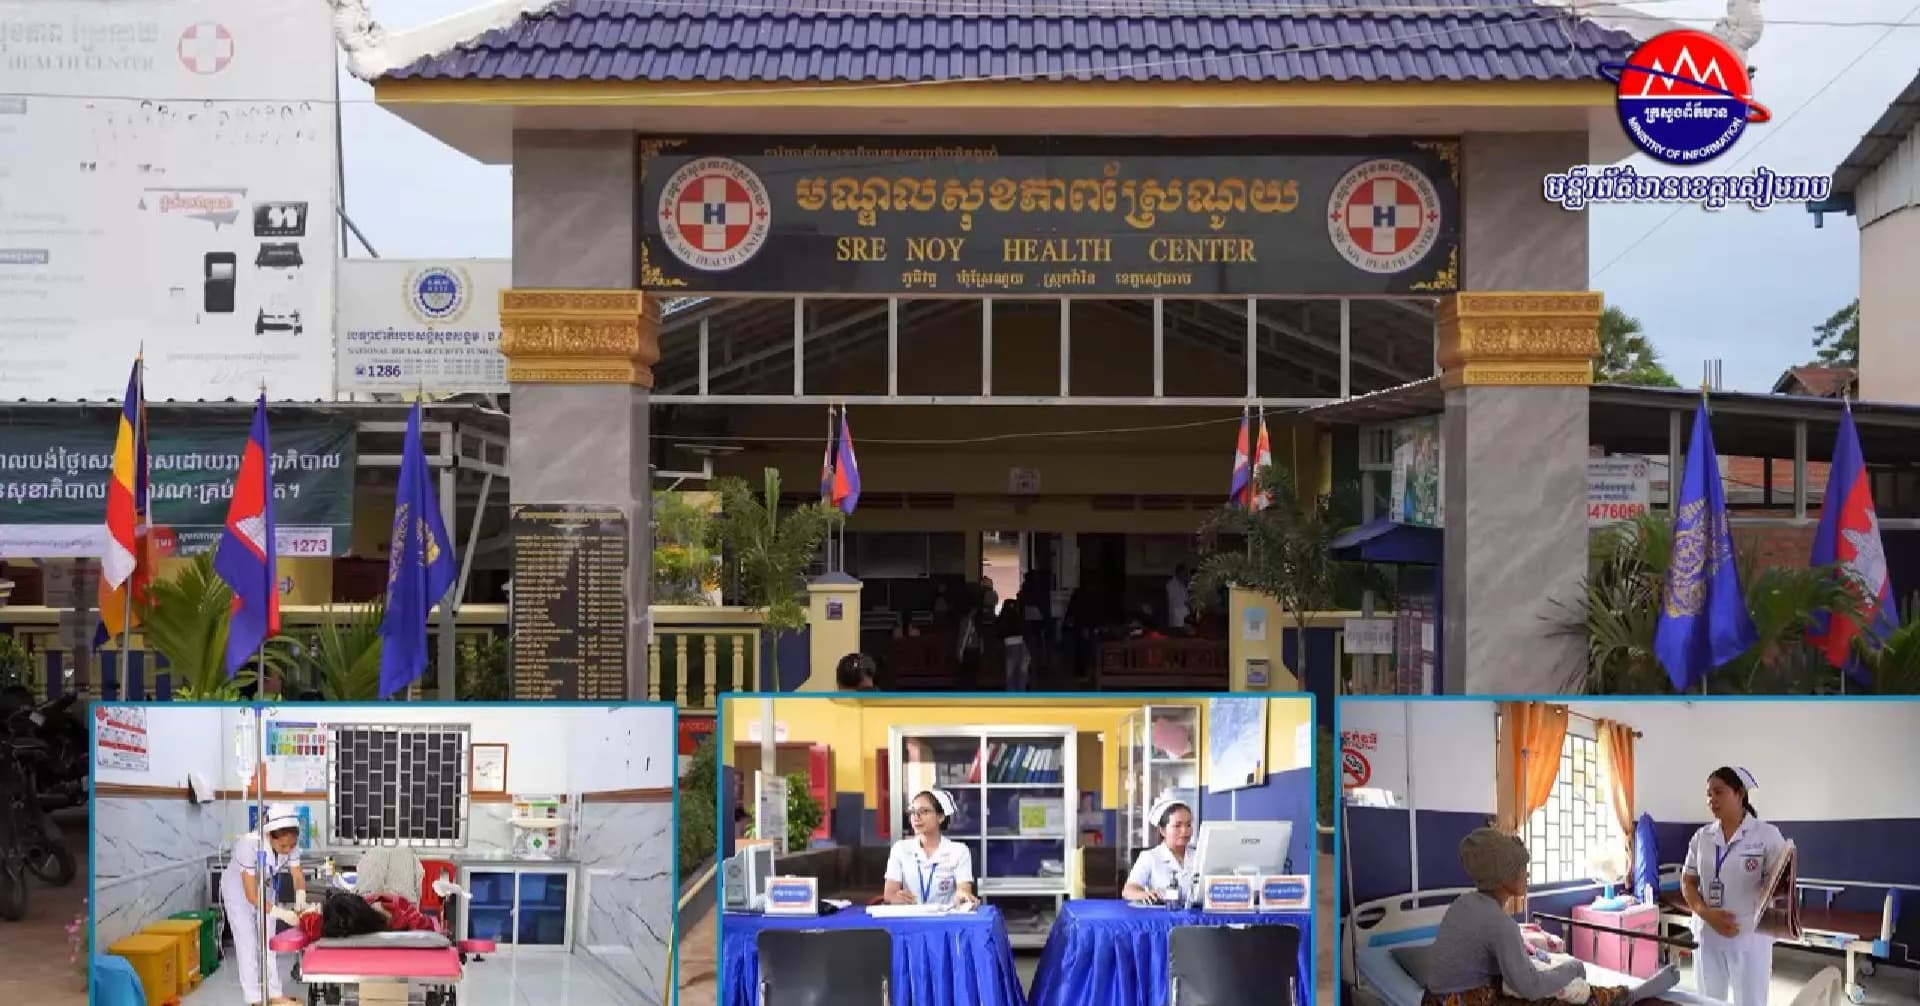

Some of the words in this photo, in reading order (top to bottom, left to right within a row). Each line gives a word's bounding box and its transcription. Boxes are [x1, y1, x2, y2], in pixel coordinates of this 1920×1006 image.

[704, 203, 725, 225] H
[1373, 206, 1395, 227] H
[837, 237, 887, 262] SRE
[906, 238, 966, 262] NOY
[1003, 239, 1112, 263] HEALTH
[1148, 239, 1257, 263] CENTER
[368, 364, 401, 378] 1286
[292, 539, 328, 552] 1273
